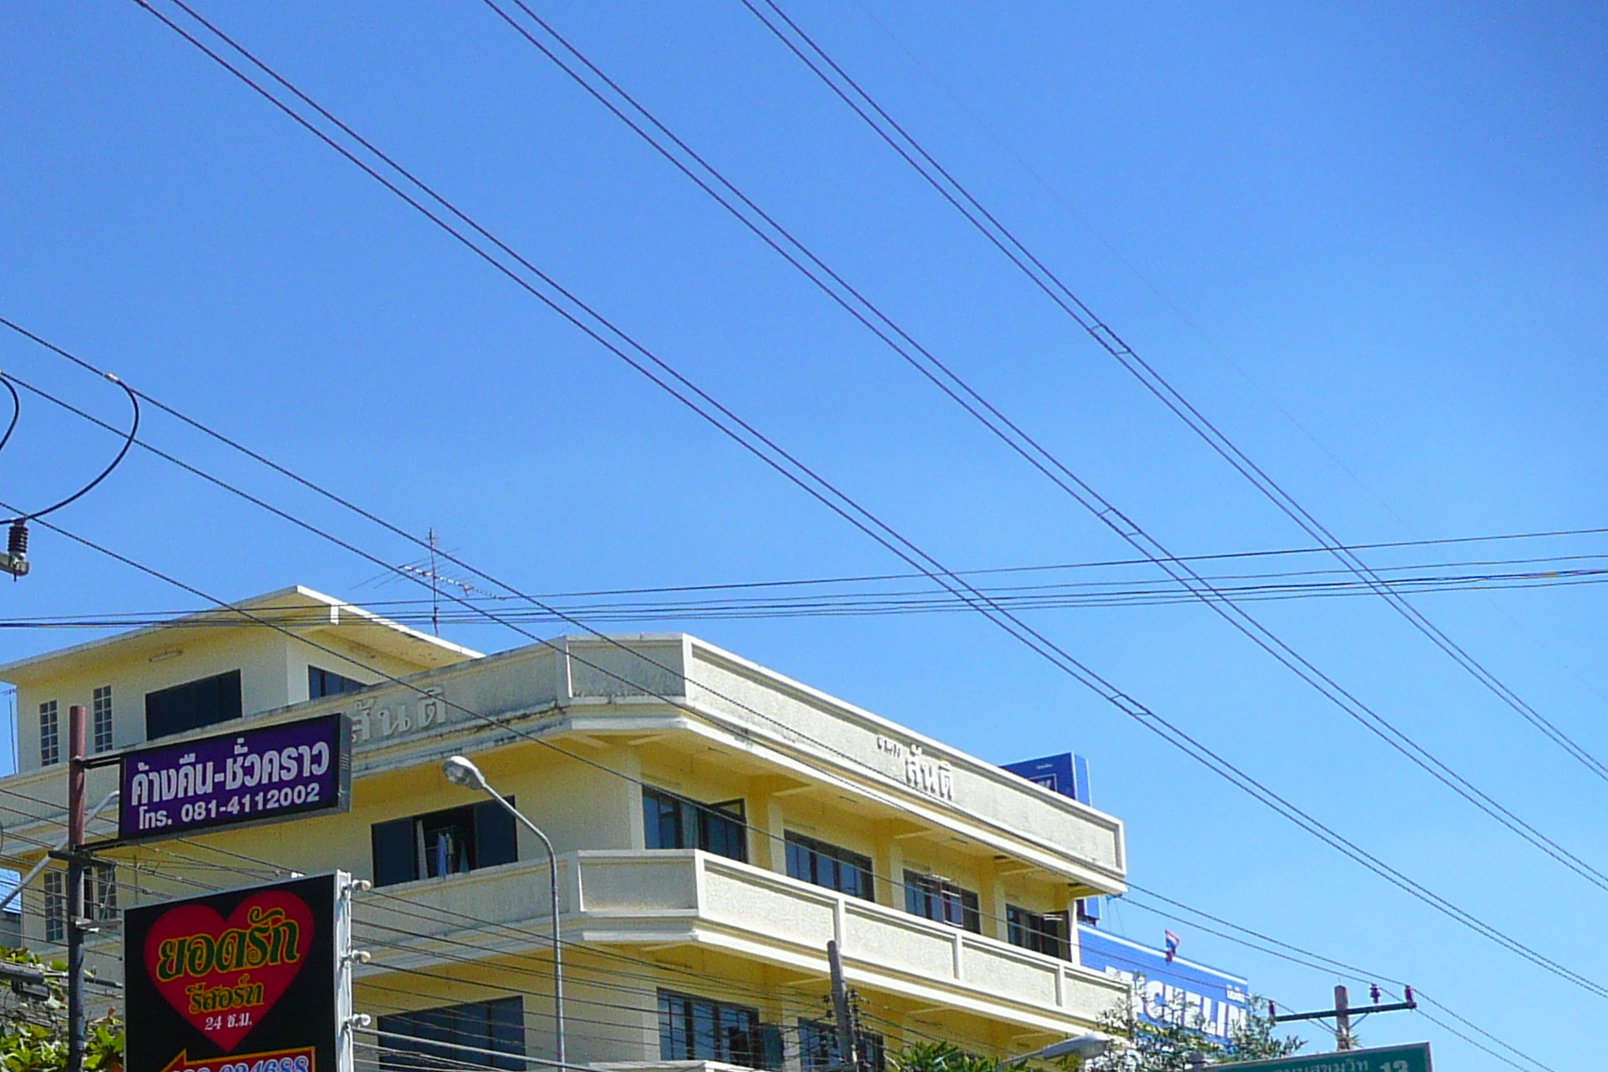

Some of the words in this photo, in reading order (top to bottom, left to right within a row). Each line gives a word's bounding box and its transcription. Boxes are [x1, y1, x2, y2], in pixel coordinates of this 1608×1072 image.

[131, 737, 330, 806] ค้างคืน-ชั่วคราว
[138, 806, 173, 830] โทร.
[180, 782, 321, 823] 081-4112002
[156, 906, 301, 983] ยอดรัก
[185, 973, 265, 1015] รีสอร์ท
[204, 1015, 222, 1031] 24
